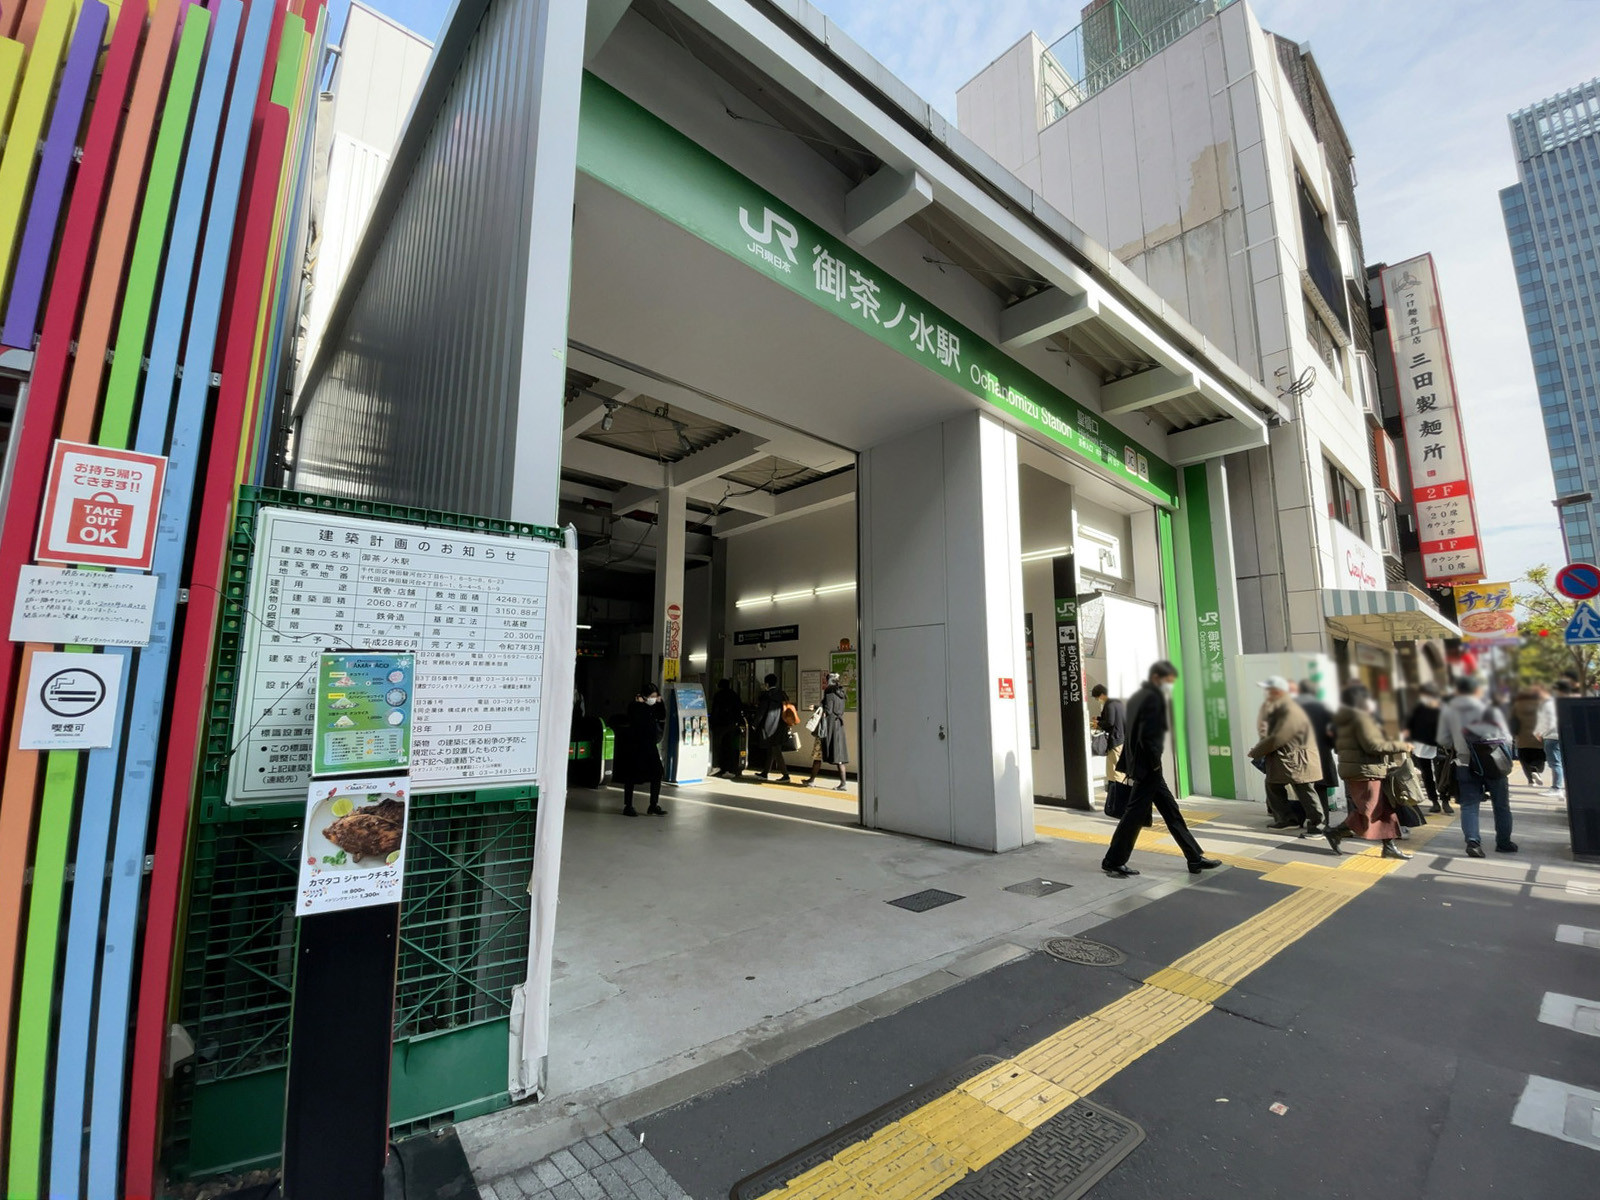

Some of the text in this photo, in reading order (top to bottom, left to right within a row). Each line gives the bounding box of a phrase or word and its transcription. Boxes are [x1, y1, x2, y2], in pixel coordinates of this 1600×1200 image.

[739, 206, 799, 265] JR
[747, 242, 791, 274] JR東日本
[812, 244, 961, 374] 御茶ノ水駅
[1405, 293, 1422, 344] つけ麺専門店
[970, 363, 1073, 439] Ochanomizu Station
[1409, 352, 1446, 462] 三田製麺所
[74, 463, 143, 481] お持ち帰り
[73, 474, 141, 493] できます!!
[1427, 485, 1454, 499] 2F
[84, 504, 123, 518] TAKE
[85, 515, 119, 526] OUT
[1427, 519, 1465, 529] カウンター
[79, 526, 118, 545] OK
[318, 528, 516, 561] 建築計画のお知らせ
[1438, 540, 1458, 550] 1F
[281, 545, 351, 560] 建築物の名称
[361, 553, 410, 566] 御茶ノ水駅
[1431, 554, 1470, 564] カウンター
[279, 559, 349, 572] 建築敷地の
[278, 567, 349, 579] 地名地番
[294, 580, 347, 592] 用途
[373, 586, 416, 597] 駅舎・店舗
[292, 593, 346, 605] 建築面積
[436, 590, 479, 601] 敷地面積
[1459, 588, 1509, 611] チゲ
[266, 578, 280, 628] 建築物の概要
[434, 603, 479, 613] 延べ面積
[1057, 602, 1076, 614] JR
[291, 607, 345, 619] 構造
[376, 612, 405, 621] 鉄骨造
[1199, 611, 1219, 623] JR
[289, 621, 344, 631] 階数
[433, 616, 478, 625] 基礎工法
[503, 620, 528, 628] 杭基礎
[271, 634, 342, 646] 着工予定
[362, 637, 418, 648] 平成28年6月
[431, 641, 476, 650] 完了予定
[499, 643, 541, 652] 令和7年3月
[269, 654, 307, 664] 建築主
[1207, 630, 1224, 682] 御茶ノ水駅
[1068, 645, 1080, 702] きっぷうりば
[265, 680, 305, 690] 設計者
[51, 723, 86, 733] 喫煙可
[472, 723, 492, 732] 20日
[308, 870, 398, 888] カマタコ ジャークチキン
